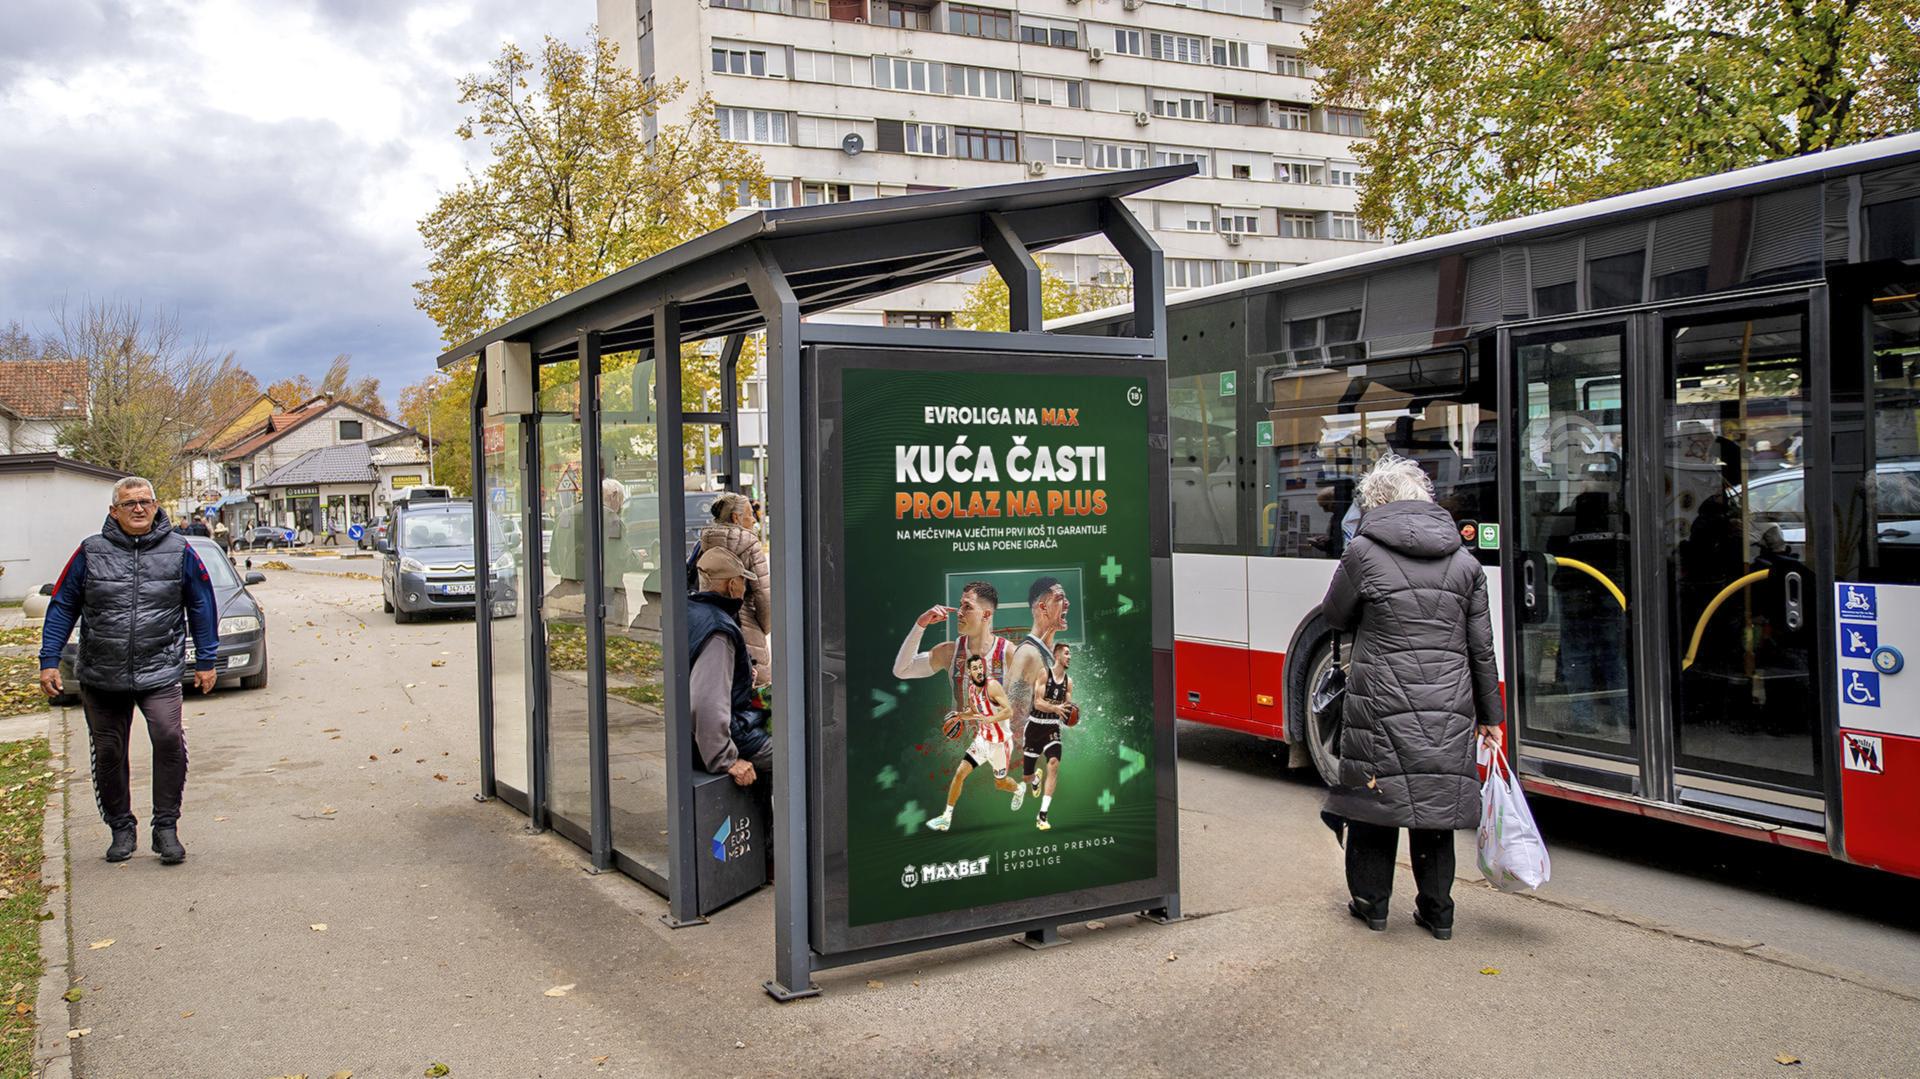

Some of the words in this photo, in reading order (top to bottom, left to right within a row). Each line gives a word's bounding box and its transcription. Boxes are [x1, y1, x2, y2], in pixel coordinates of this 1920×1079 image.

[1130, 392, 1140, 400] 18
[924, 406, 1012, 425] EVROLIGA
[1016, 408, 1038, 425] NA
[1041, 408, 1079, 427] MAX
[895, 435, 1000, 484] KUĆA
[1006, 435, 1106, 482] ČASTI
[895, 491, 1001, 520] PROLAZ
[1006, 490, 1043, 518] NA
[1047, 488, 1108, 517] PLUS
[896, 530, 911, 540] NA
[913, 527, 962, 540] MEČEVIMA
[964, 526, 1004, 538] VJEČITIH
[1005, 527, 1026, 537] PRVI
[1027, 524, 1045, 536] KOŠ
[1047, 526, 1055, 536] TI
[1056, 525, 1107, 536] GARANTUJE
[952, 541, 976, 552] PLUS
[977, 541, 991, 551] NA
[992, 540, 1022, 550] POENE
[1023, 537, 1058, 549] IGRAČA
[735, 816, 750, 832] LED
[731, 829, 751, 847] EURO
[1003, 844, 1058, 860] SPONZOR
[1064, 836, 1115, 851] PRENOSA
[1004, 856, 1061, 872] EVROLIGE
